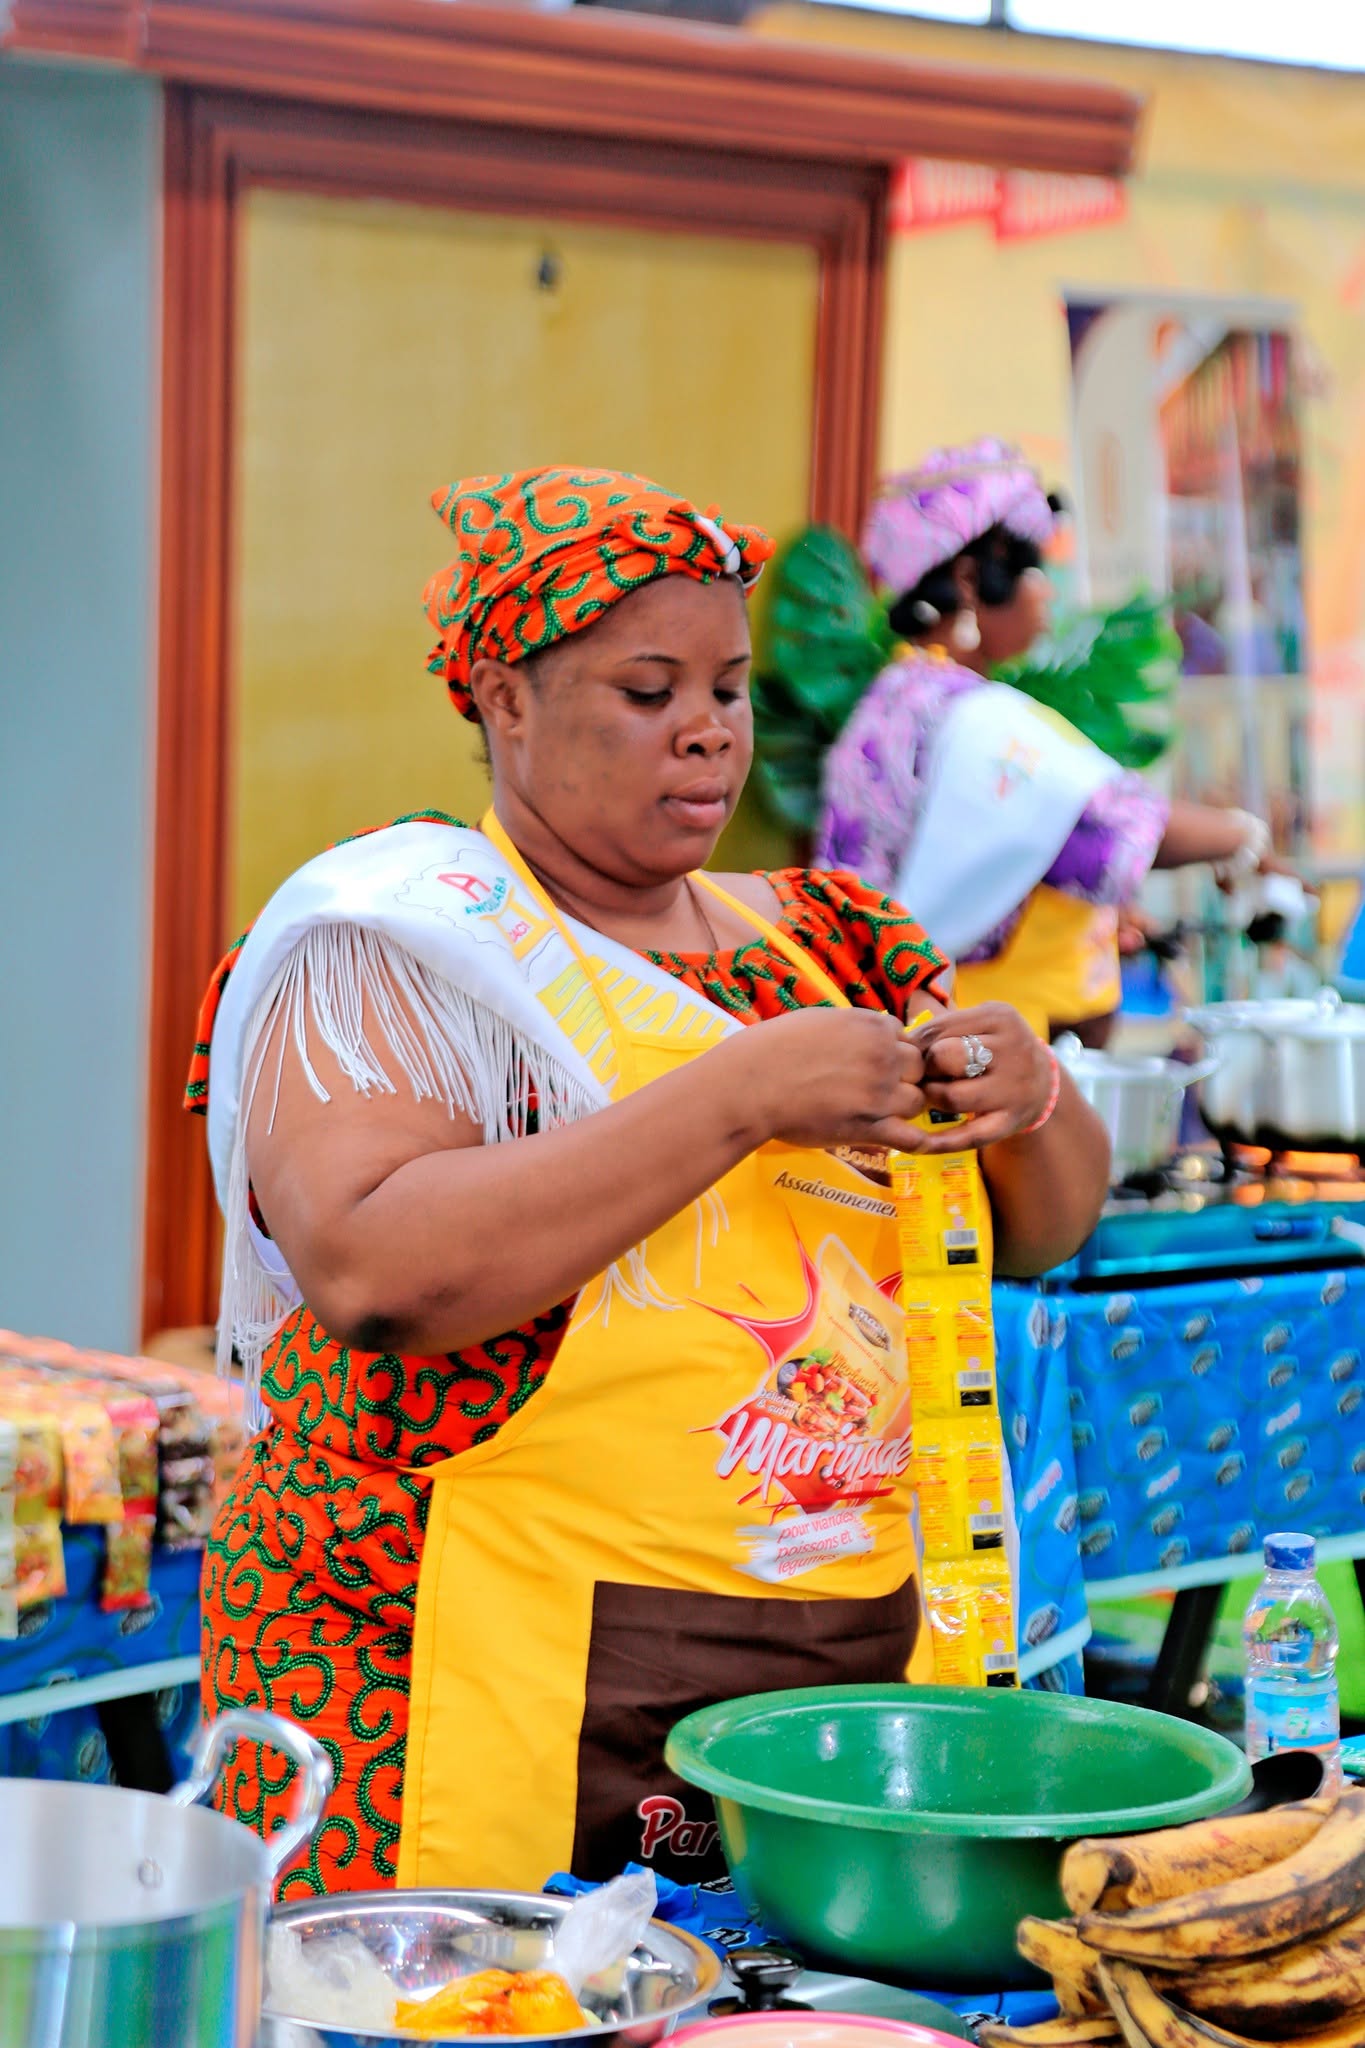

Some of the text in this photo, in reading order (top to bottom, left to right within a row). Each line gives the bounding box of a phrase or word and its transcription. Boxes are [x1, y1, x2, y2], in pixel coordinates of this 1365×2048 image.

[717, 1411, 912, 1504] Marinade
[775, 1529, 853, 1562] poissons et
[777, 1521, 810, 1544] pour
